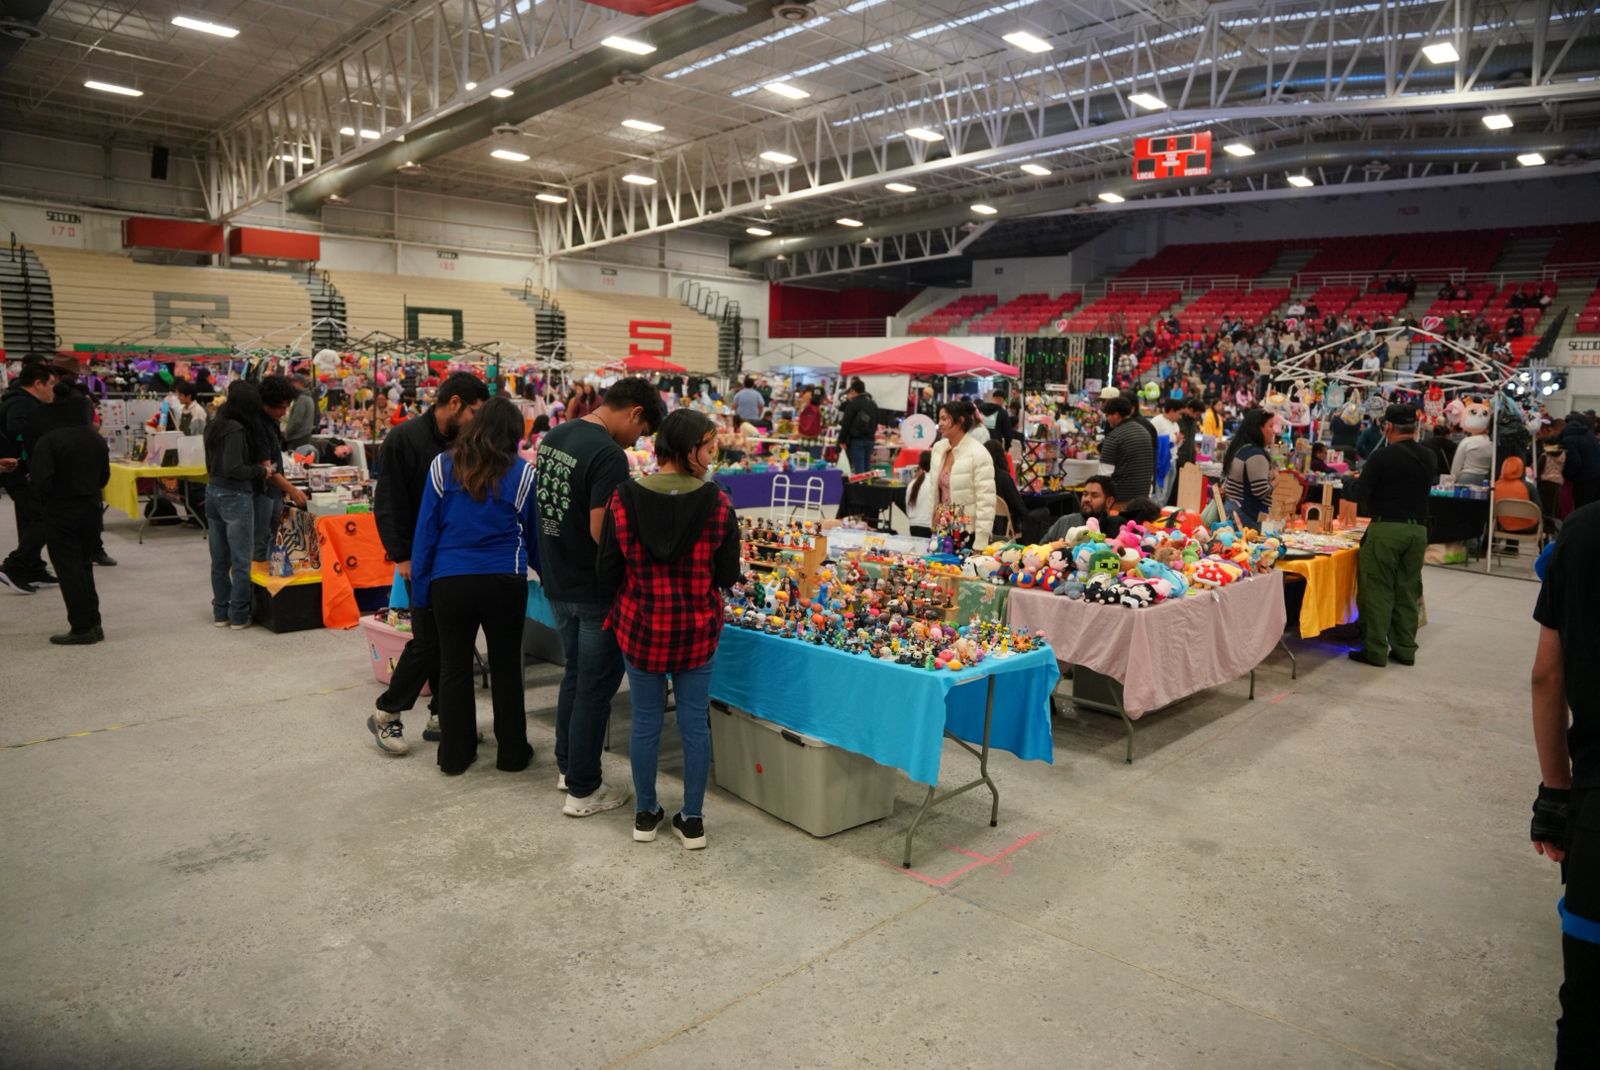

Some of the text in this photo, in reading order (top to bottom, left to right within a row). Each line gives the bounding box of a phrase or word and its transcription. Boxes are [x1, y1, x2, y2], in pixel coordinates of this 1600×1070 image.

[1136, 171, 1156, 180] LOCAL
[153, 291, 231, 341] R
[629, 319, 672, 357] S
